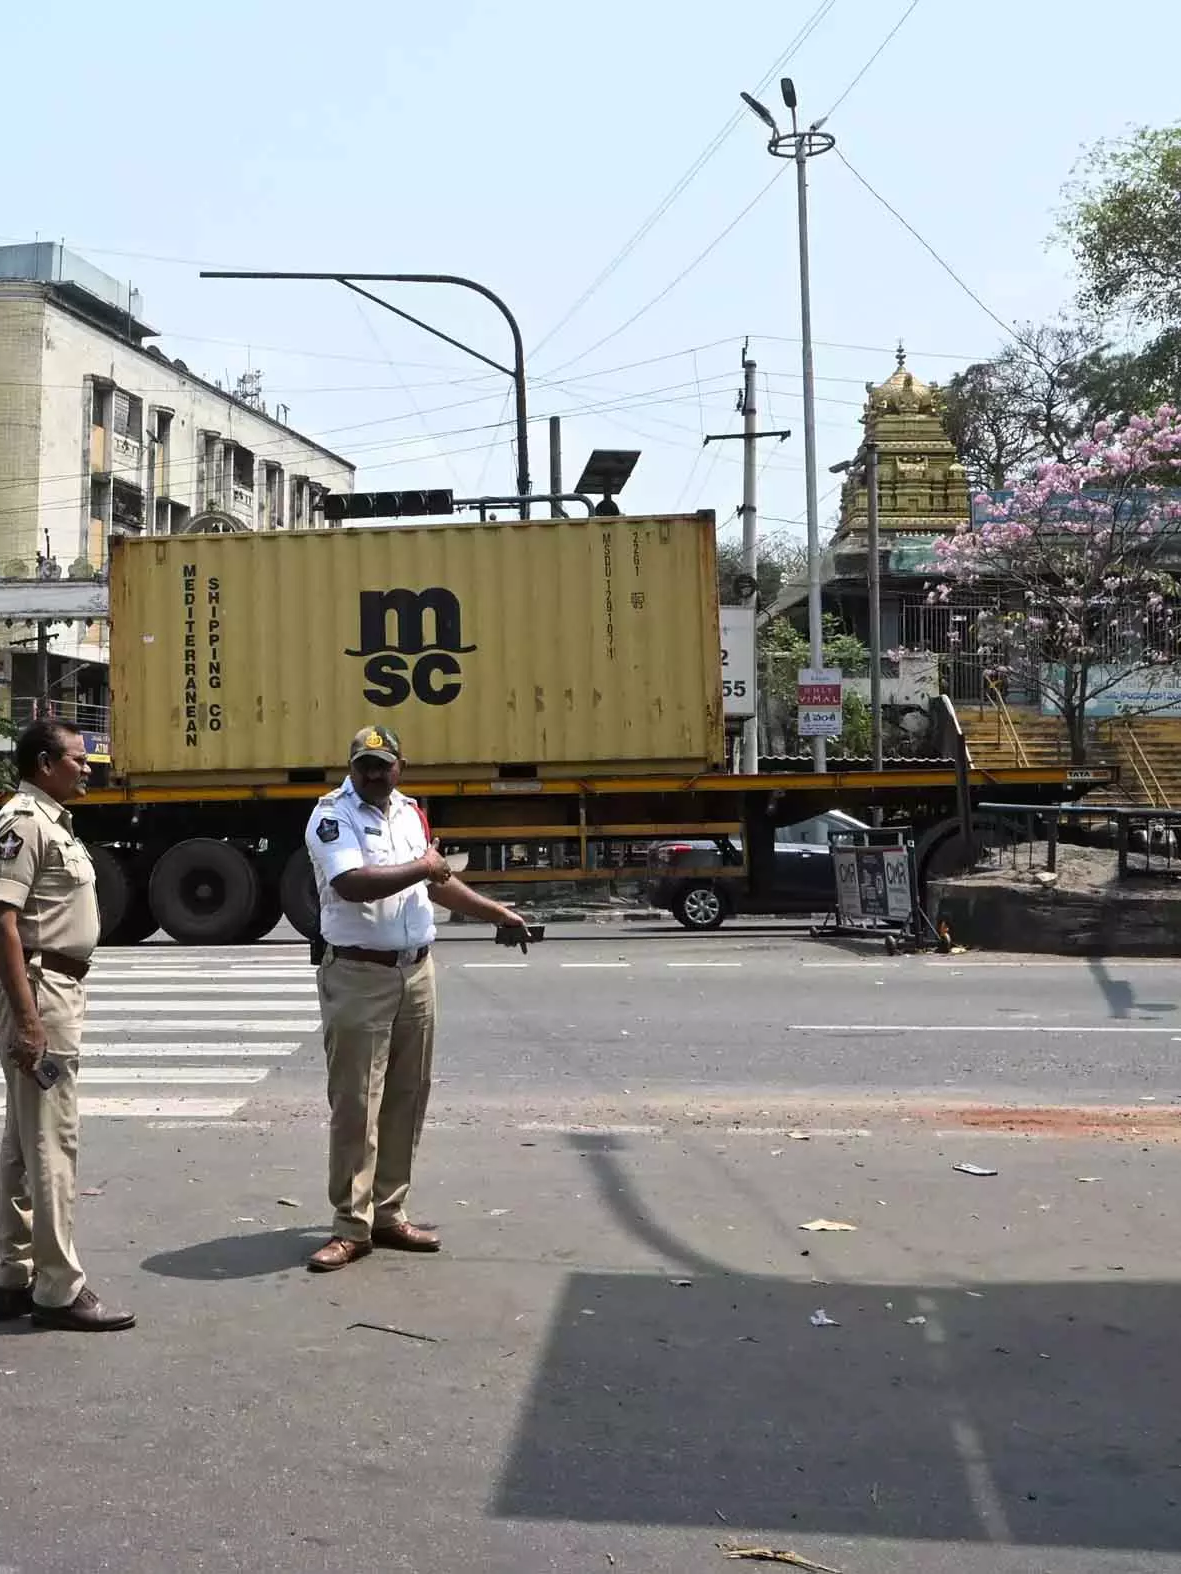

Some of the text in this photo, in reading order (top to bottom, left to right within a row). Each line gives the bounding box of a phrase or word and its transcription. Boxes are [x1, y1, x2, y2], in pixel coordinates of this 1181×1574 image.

[183, 565, 197, 746] MEDITERRANEAN
[208, 578, 221, 731] SHIPPING CO
[722, 680, 746, 697] 55
[799, 695, 838, 703] VIMAL
